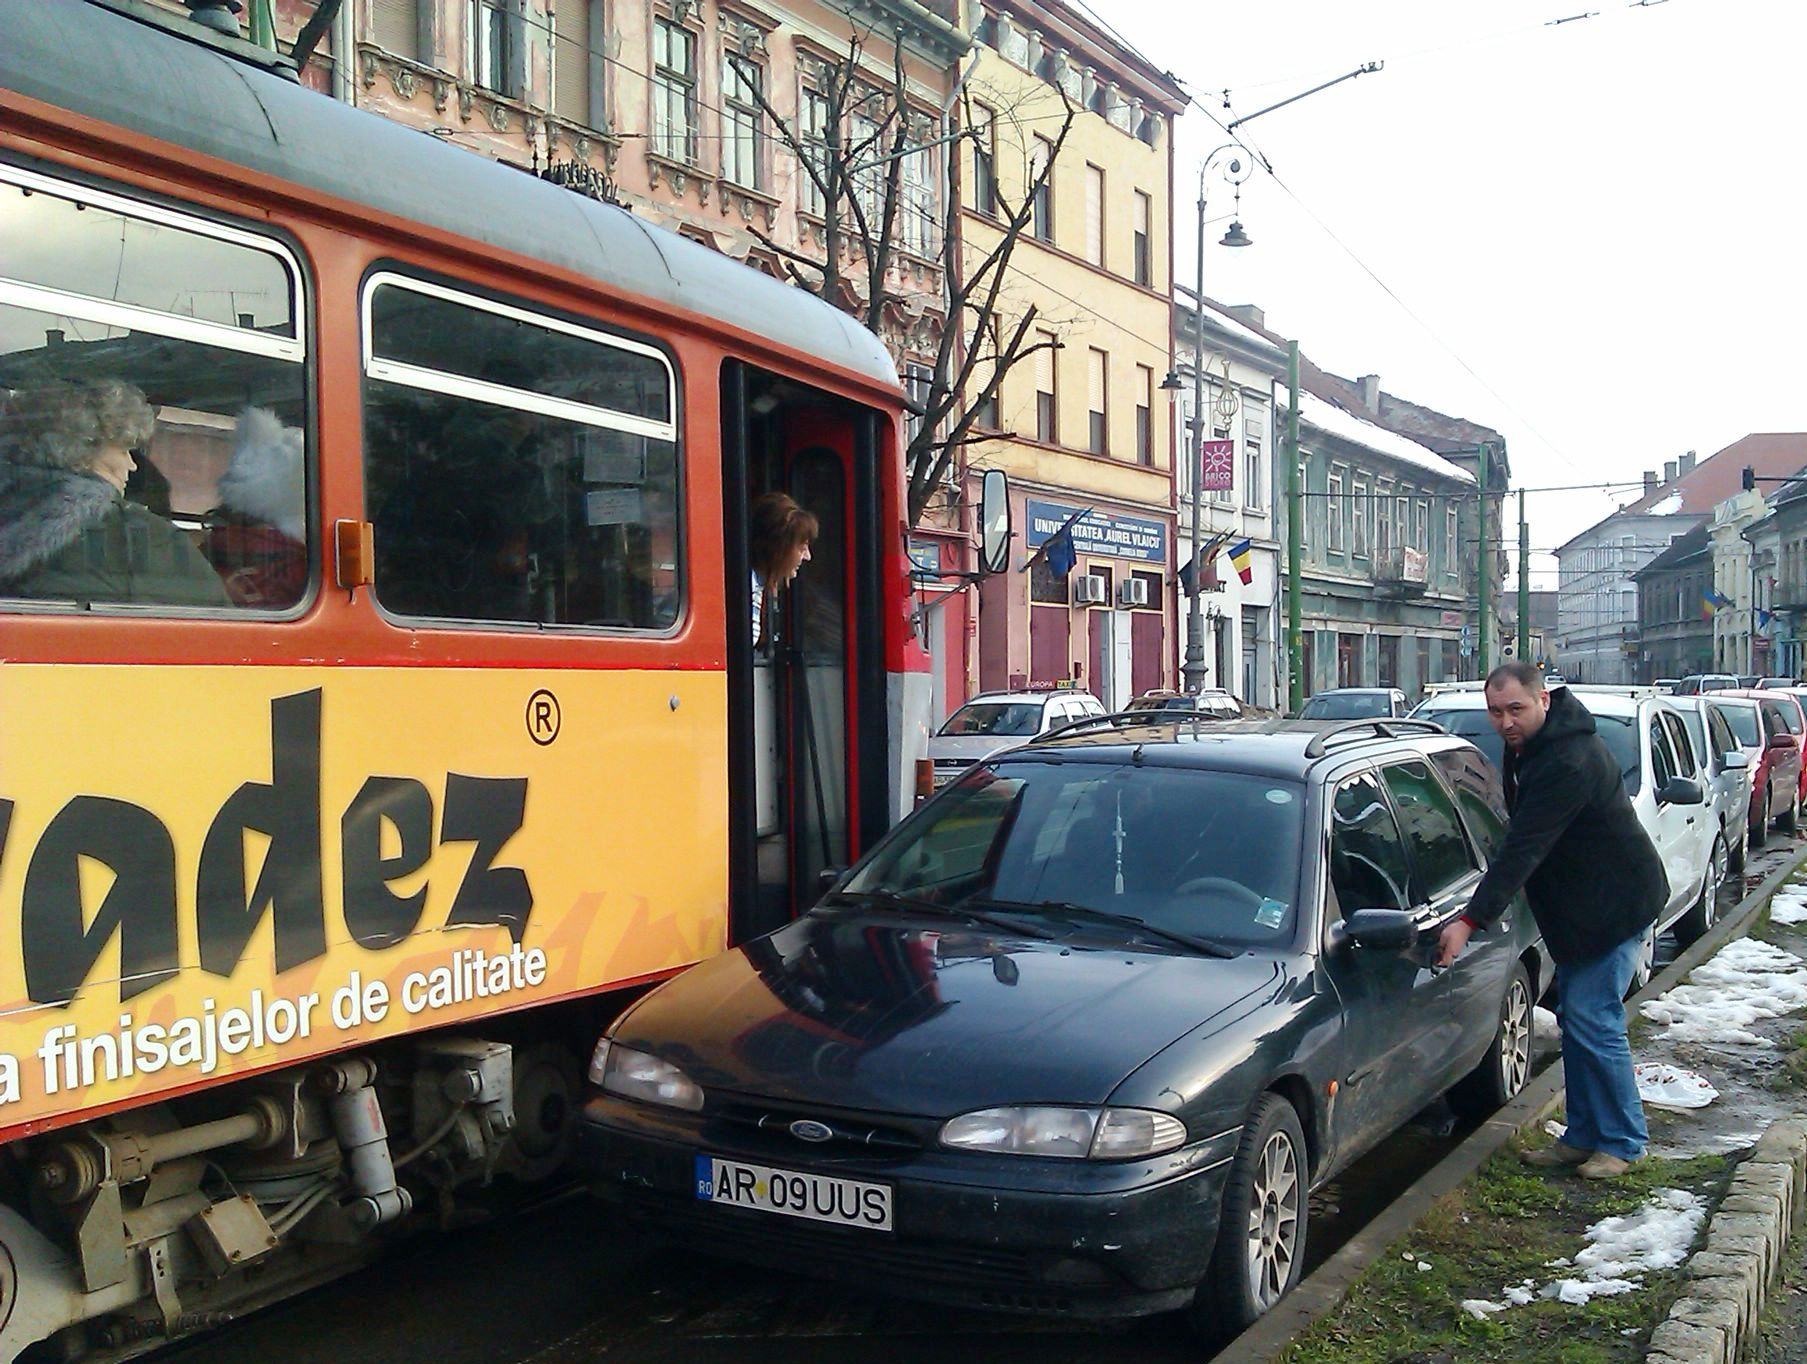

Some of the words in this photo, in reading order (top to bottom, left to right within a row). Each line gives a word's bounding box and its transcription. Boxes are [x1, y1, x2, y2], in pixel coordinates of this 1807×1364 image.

[1034, 519, 1103, 541] UNIVESITATEA
[0, 686, 534, 1010] adez
[38, 989, 319, 1096] finisajelor
[331, 970, 390, 1032] de
[402, 942, 548, 1015] calitate
